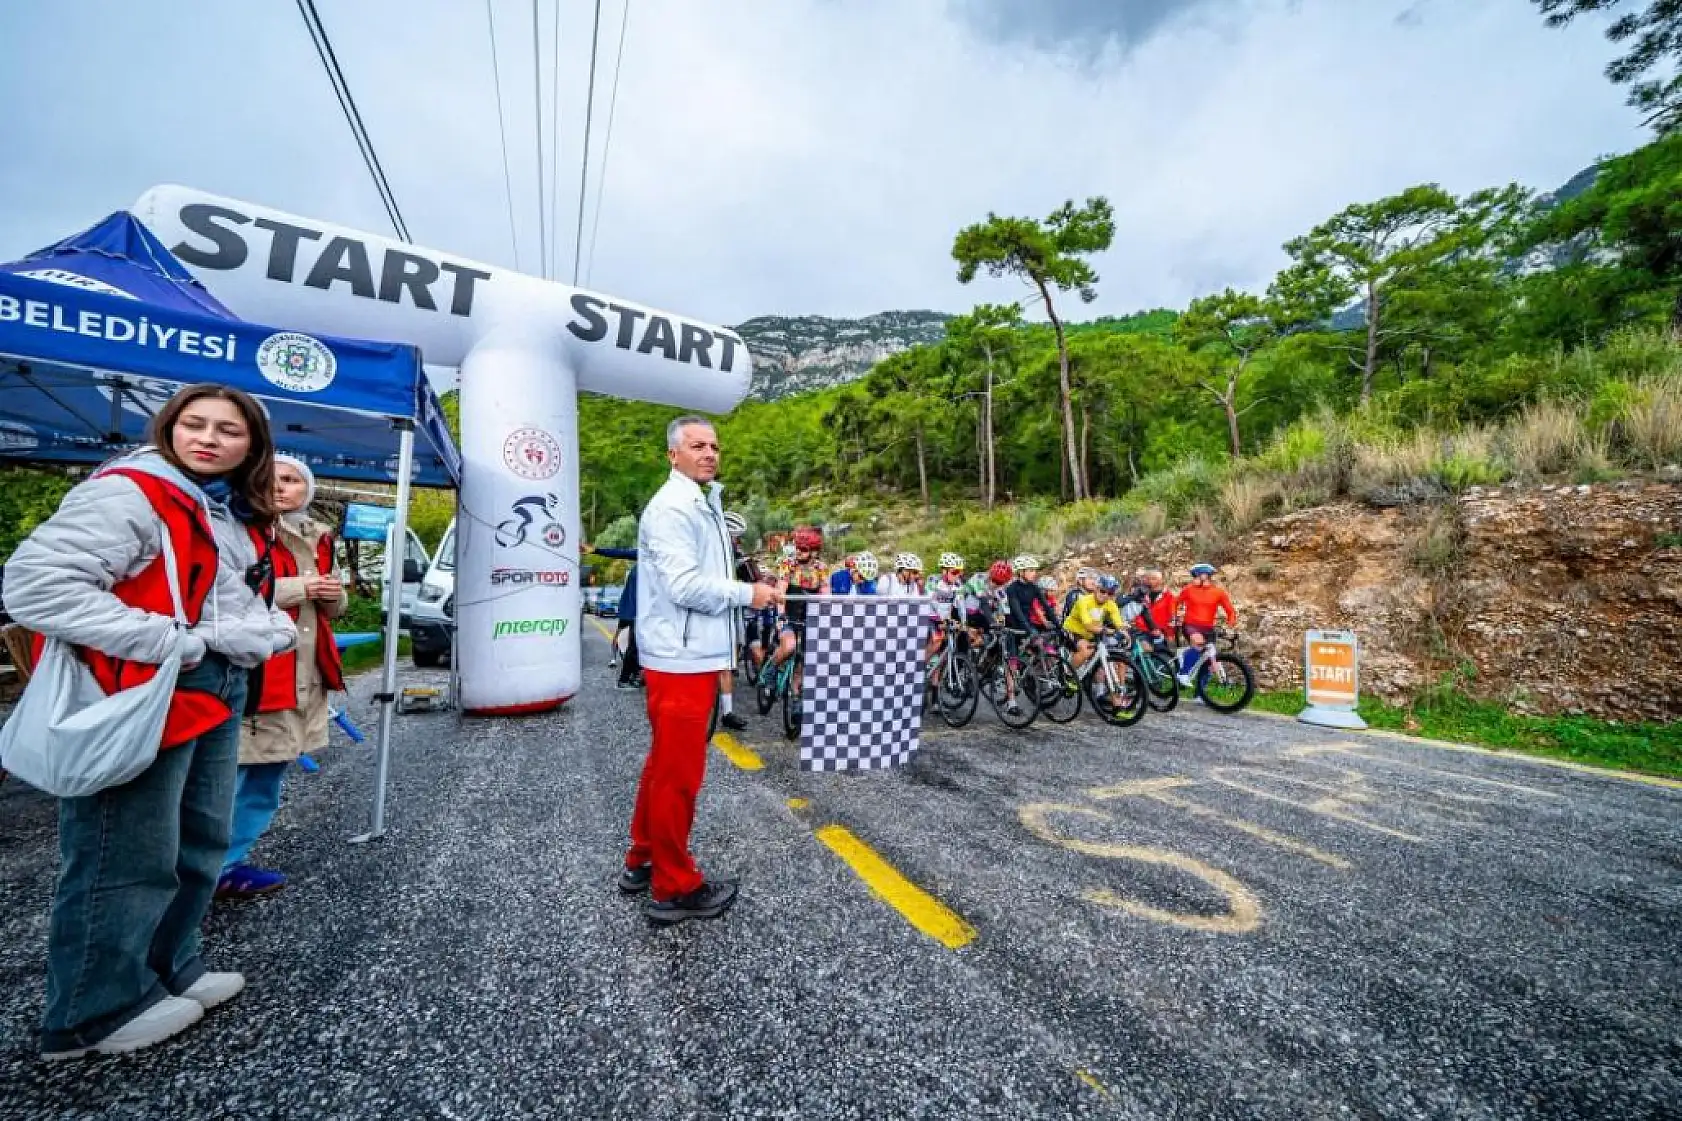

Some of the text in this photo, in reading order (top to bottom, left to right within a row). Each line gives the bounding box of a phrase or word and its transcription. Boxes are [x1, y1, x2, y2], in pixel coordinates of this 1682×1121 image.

[171, 203, 492, 317] START
[0, 294, 237, 362] BELEDİYESİ
[566, 294, 742, 372] START
[1309, 664, 1353, 685] START
